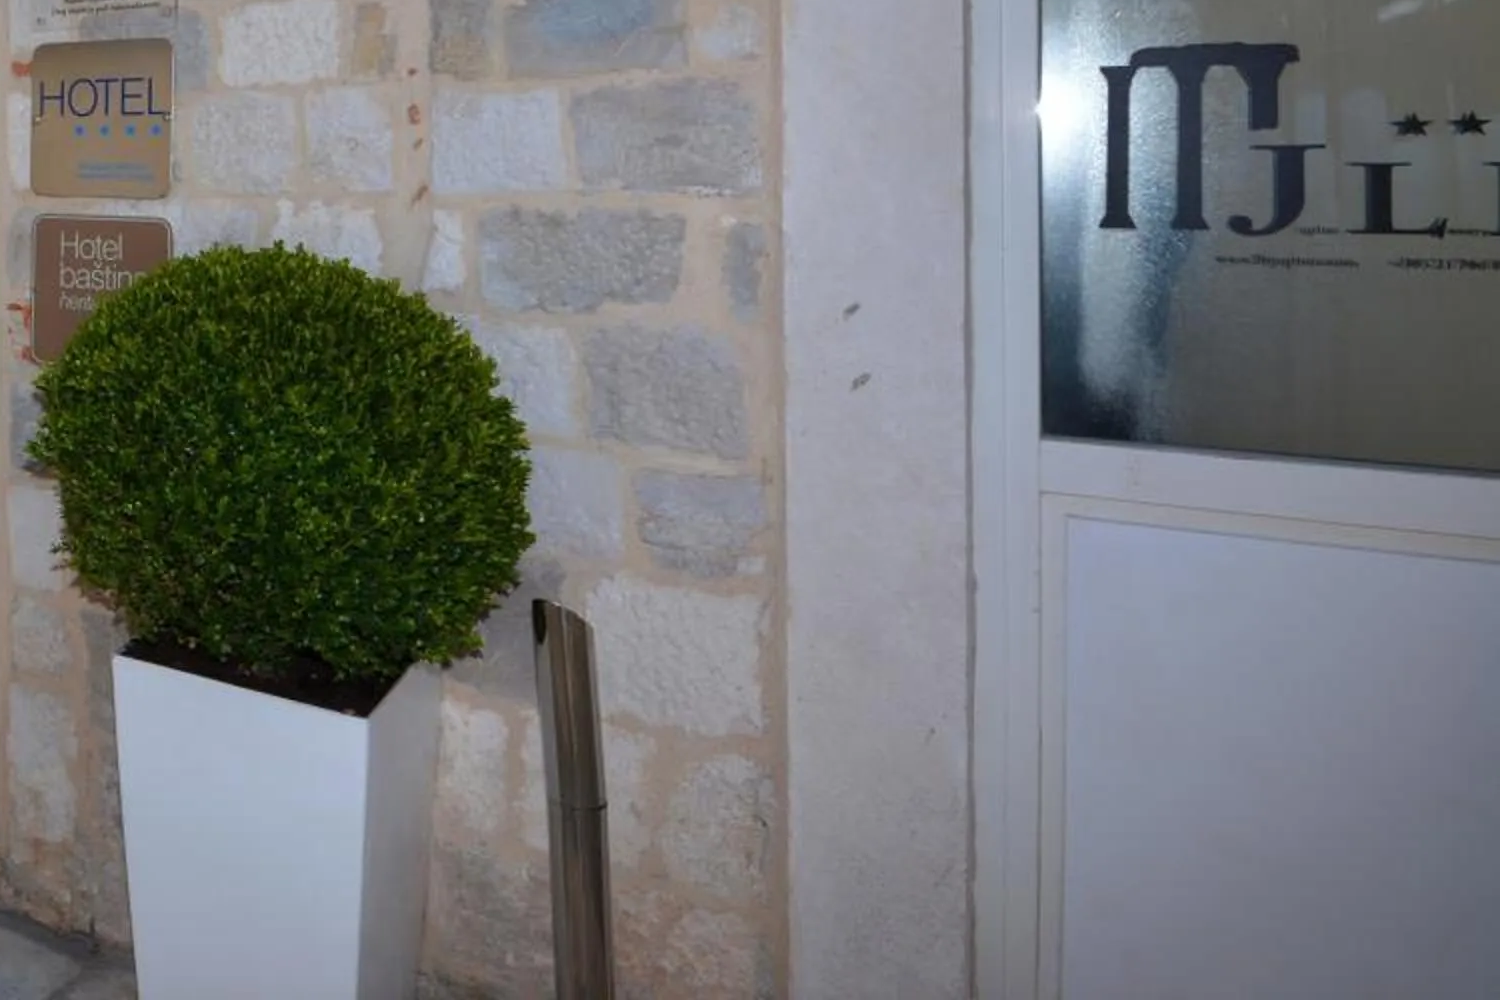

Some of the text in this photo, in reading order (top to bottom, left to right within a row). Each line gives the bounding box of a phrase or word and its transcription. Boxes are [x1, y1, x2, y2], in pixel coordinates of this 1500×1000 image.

[39, 77, 171, 118] HOTEL
[1226, 143, 1500, 237] JL
[61, 230, 123, 261] Hotel
